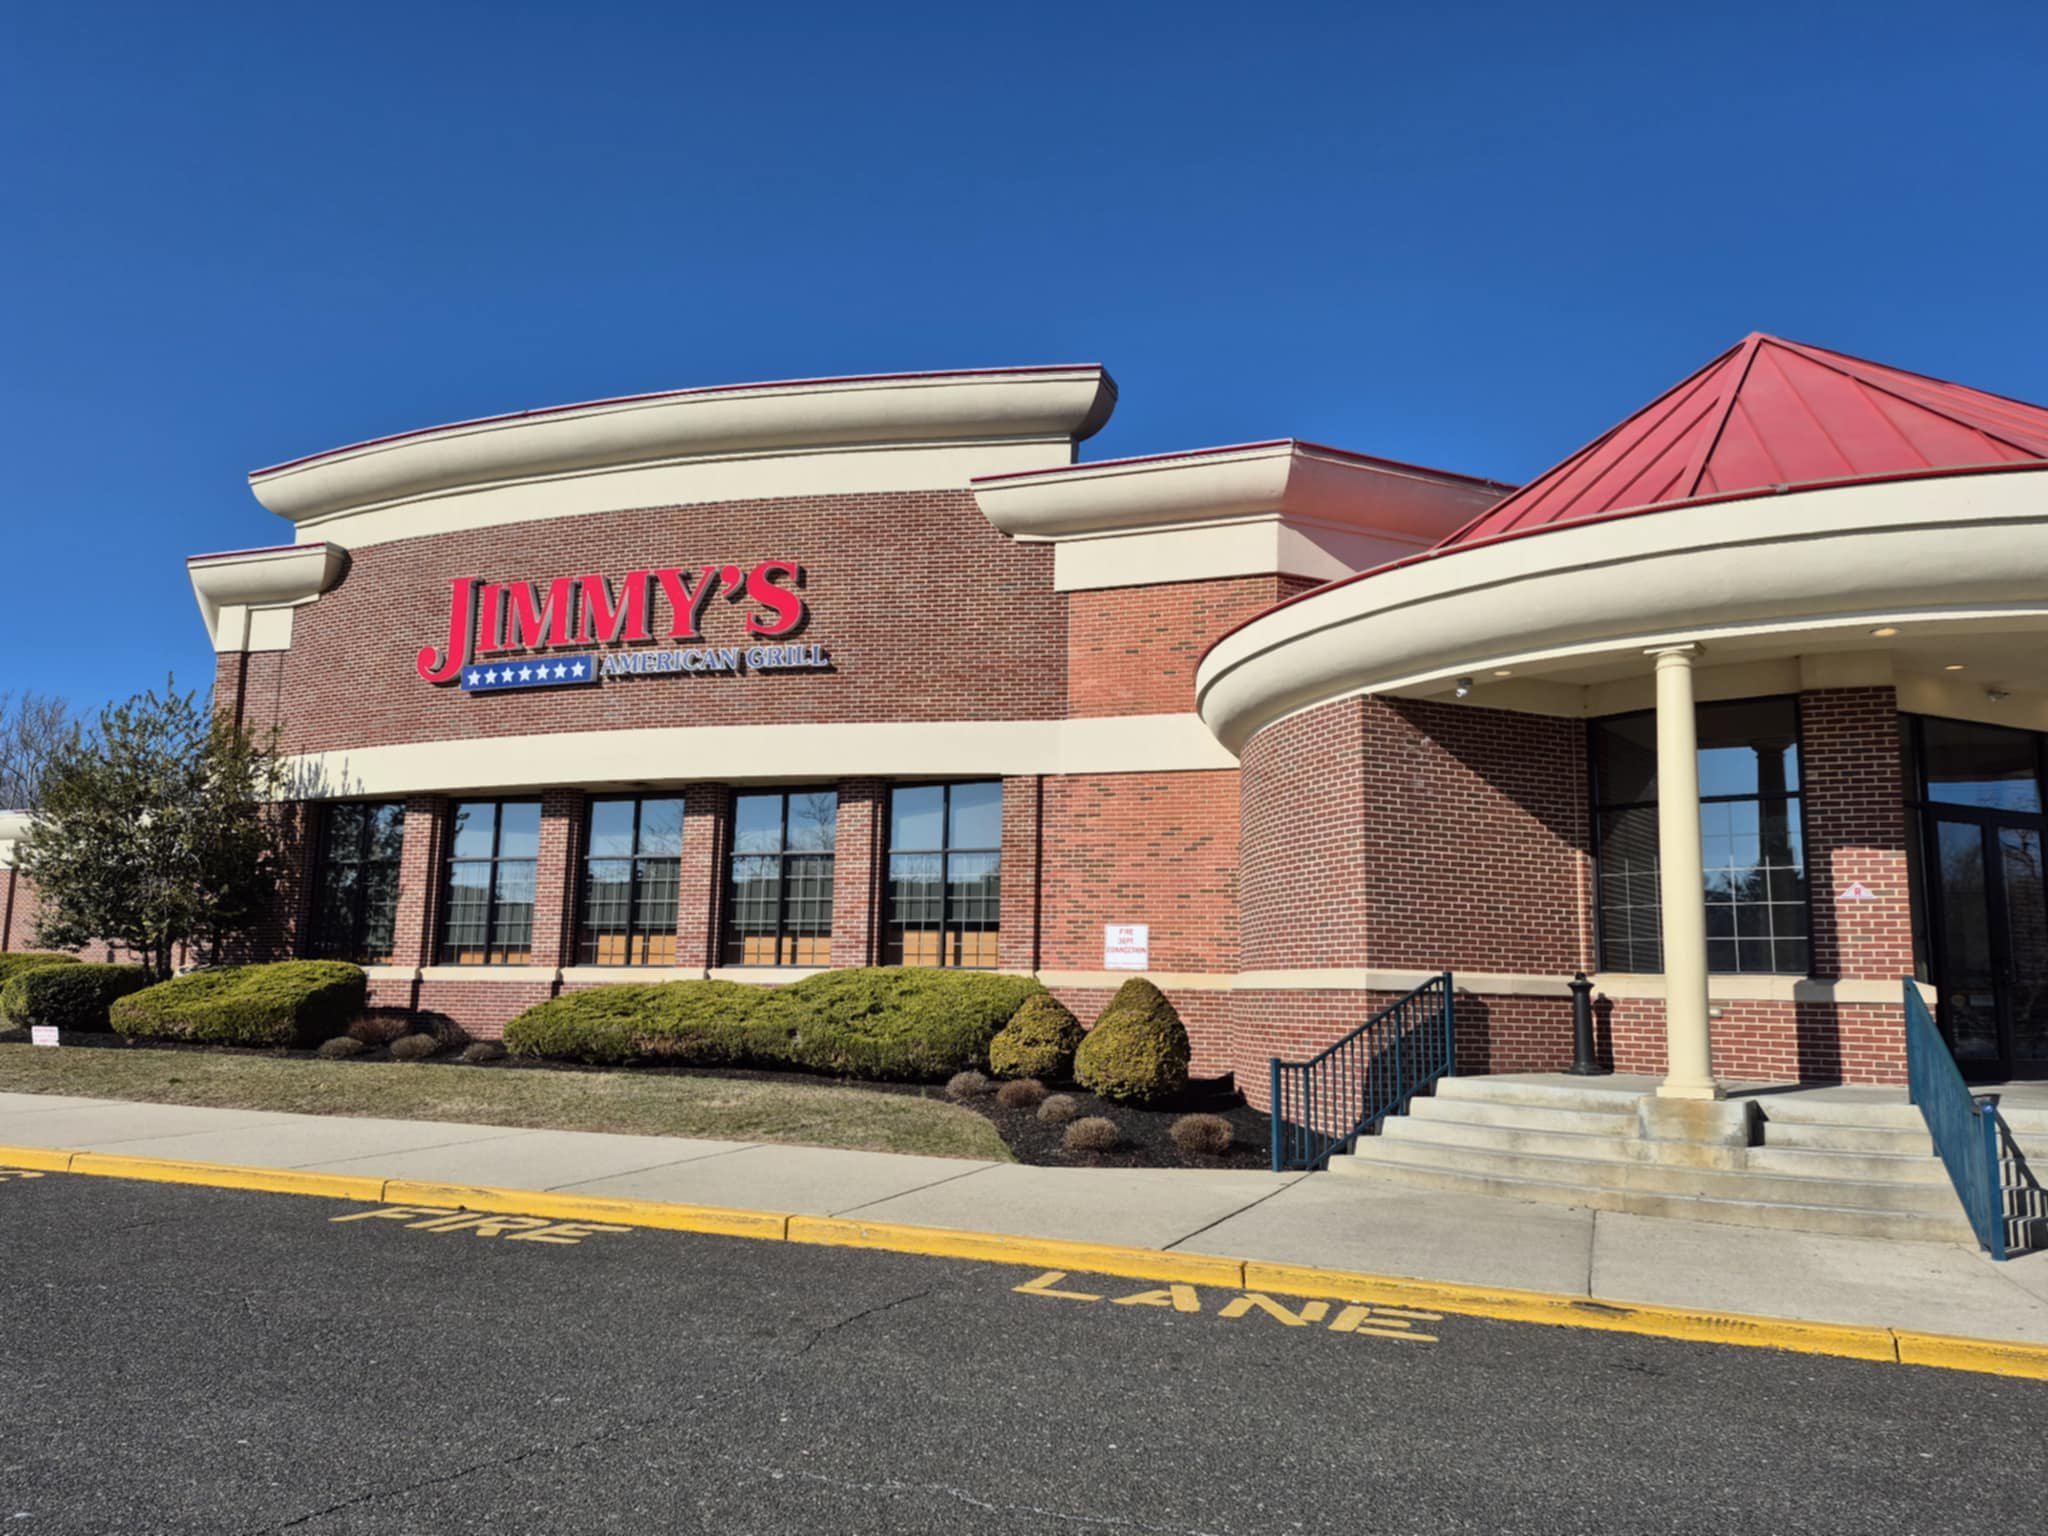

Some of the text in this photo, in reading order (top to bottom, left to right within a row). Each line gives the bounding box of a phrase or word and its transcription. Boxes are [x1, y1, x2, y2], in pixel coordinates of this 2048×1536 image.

[416, 559, 804, 684] JIMMY'S
[600, 645, 829, 676] AMERICAN GRILL
[328, 1206, 633, 1244] FIRE
[1011, 1271, 1444, 1342] LANE
